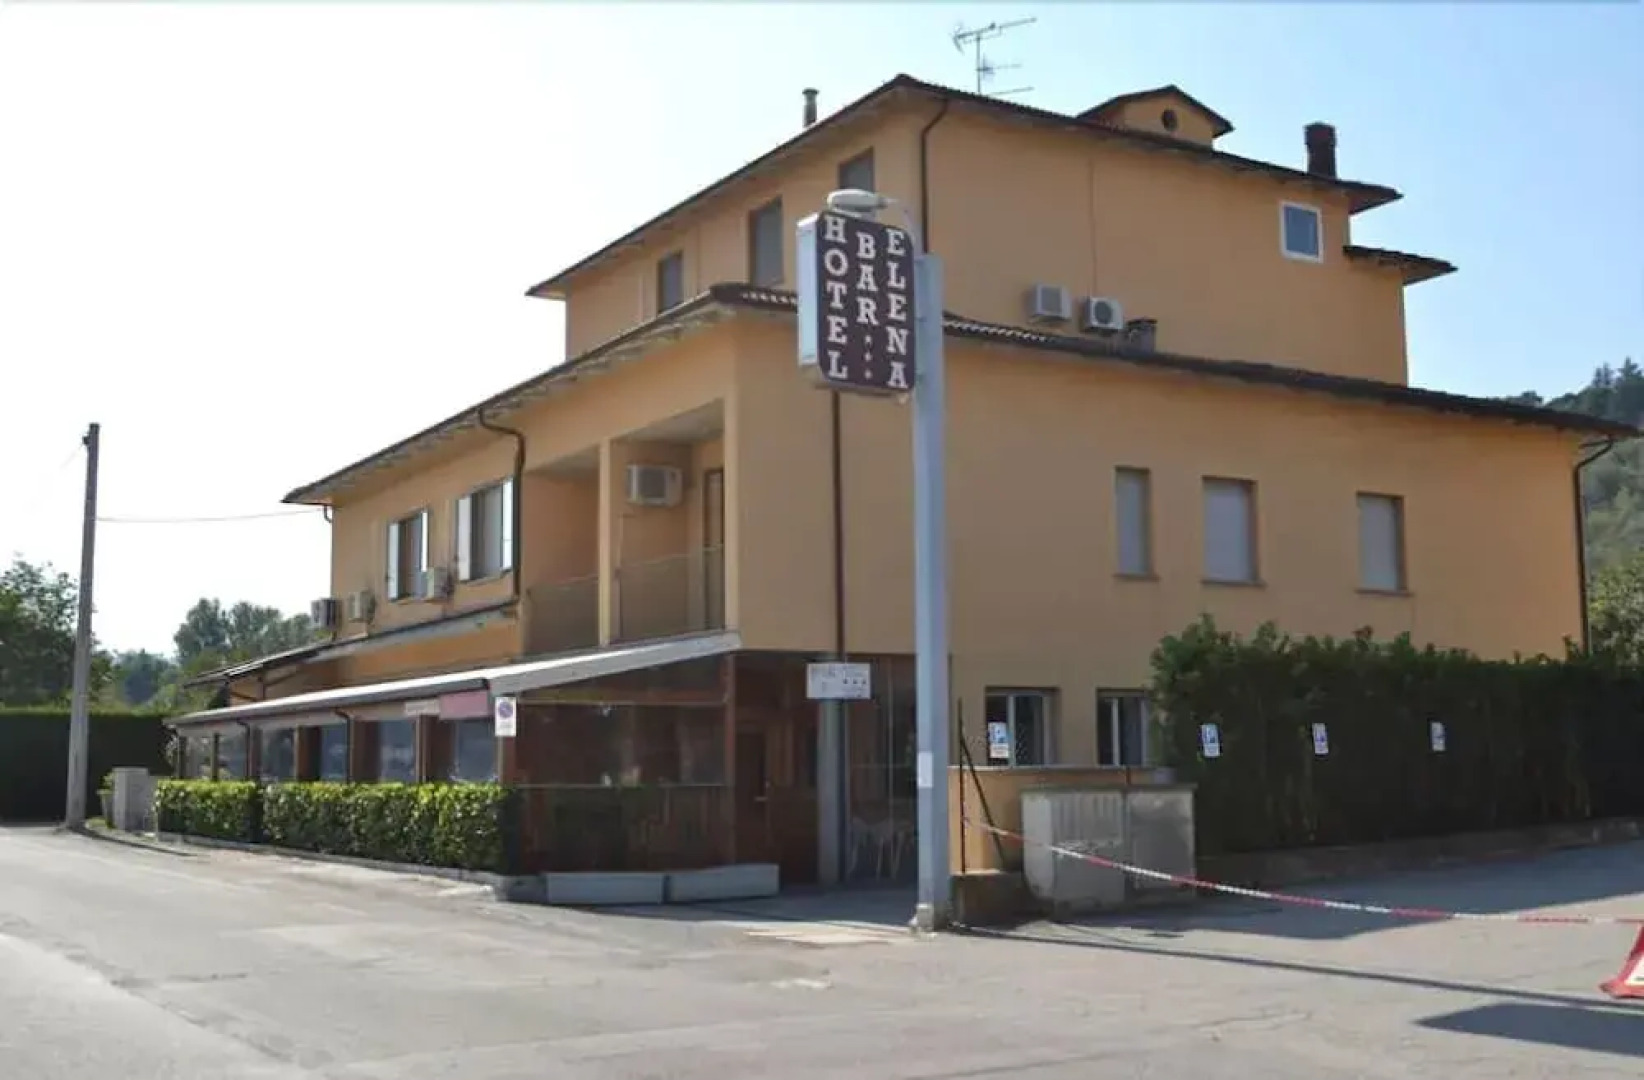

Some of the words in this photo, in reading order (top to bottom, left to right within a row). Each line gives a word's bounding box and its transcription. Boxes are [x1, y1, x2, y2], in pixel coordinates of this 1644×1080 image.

[824, 215, 848, 379] HOTEL
[856, 232, 879, 326] BAR
[885, 229, 909, 389] ELENA
